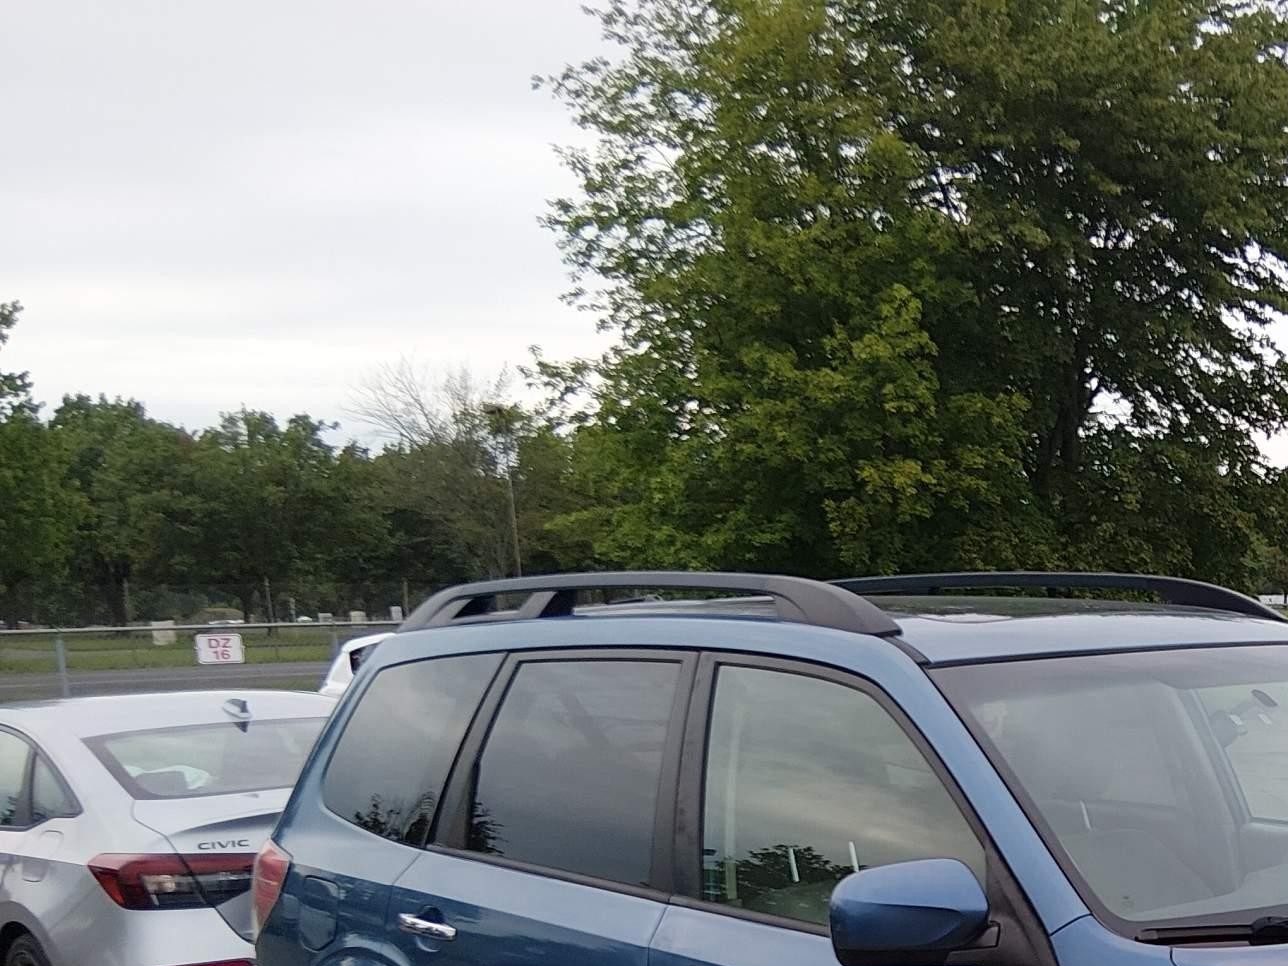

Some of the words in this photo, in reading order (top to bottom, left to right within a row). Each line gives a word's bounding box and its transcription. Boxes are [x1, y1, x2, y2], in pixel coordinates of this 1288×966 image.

[207, 638, 232, 648] DZ
[212, 649, 232, 660] 16
[197, 839, 250, 850] CIVIC
